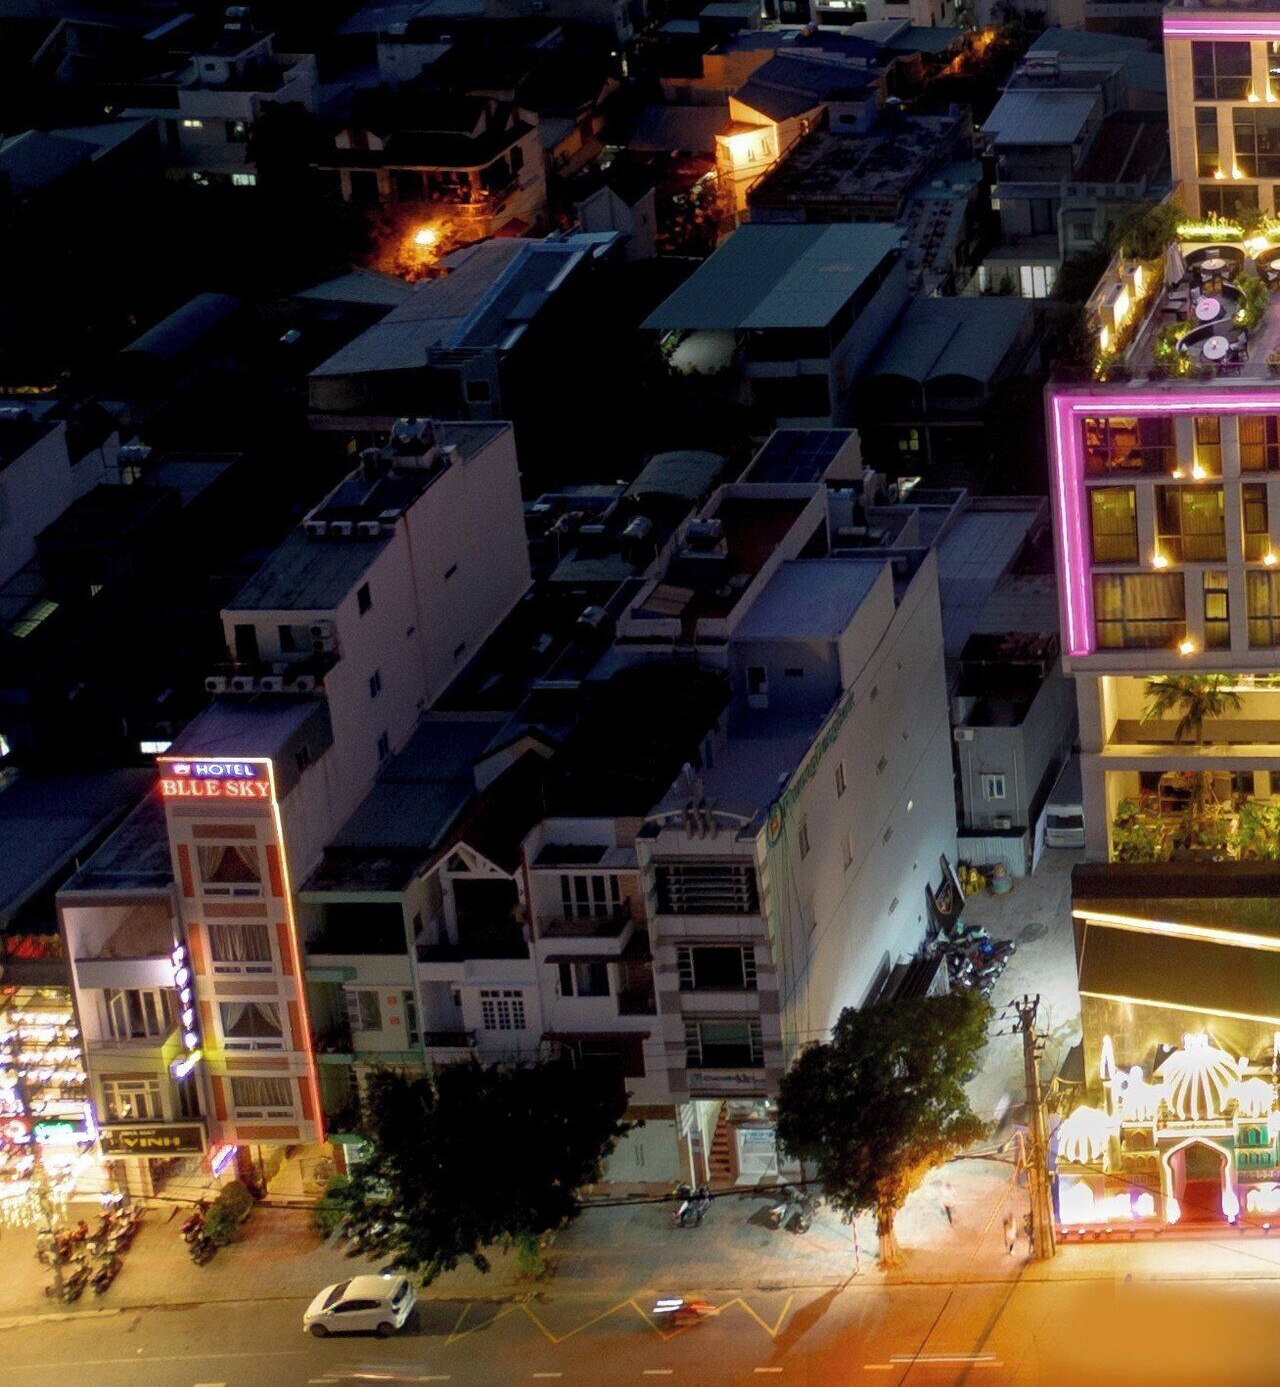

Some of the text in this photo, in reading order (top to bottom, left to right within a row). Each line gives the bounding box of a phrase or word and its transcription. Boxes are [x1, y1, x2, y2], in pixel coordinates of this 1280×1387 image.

[196, 764, 254, 775] HOTEL
[226, 780, 269, 796] SKY
[124, 1137, 180, 1147] VINH
